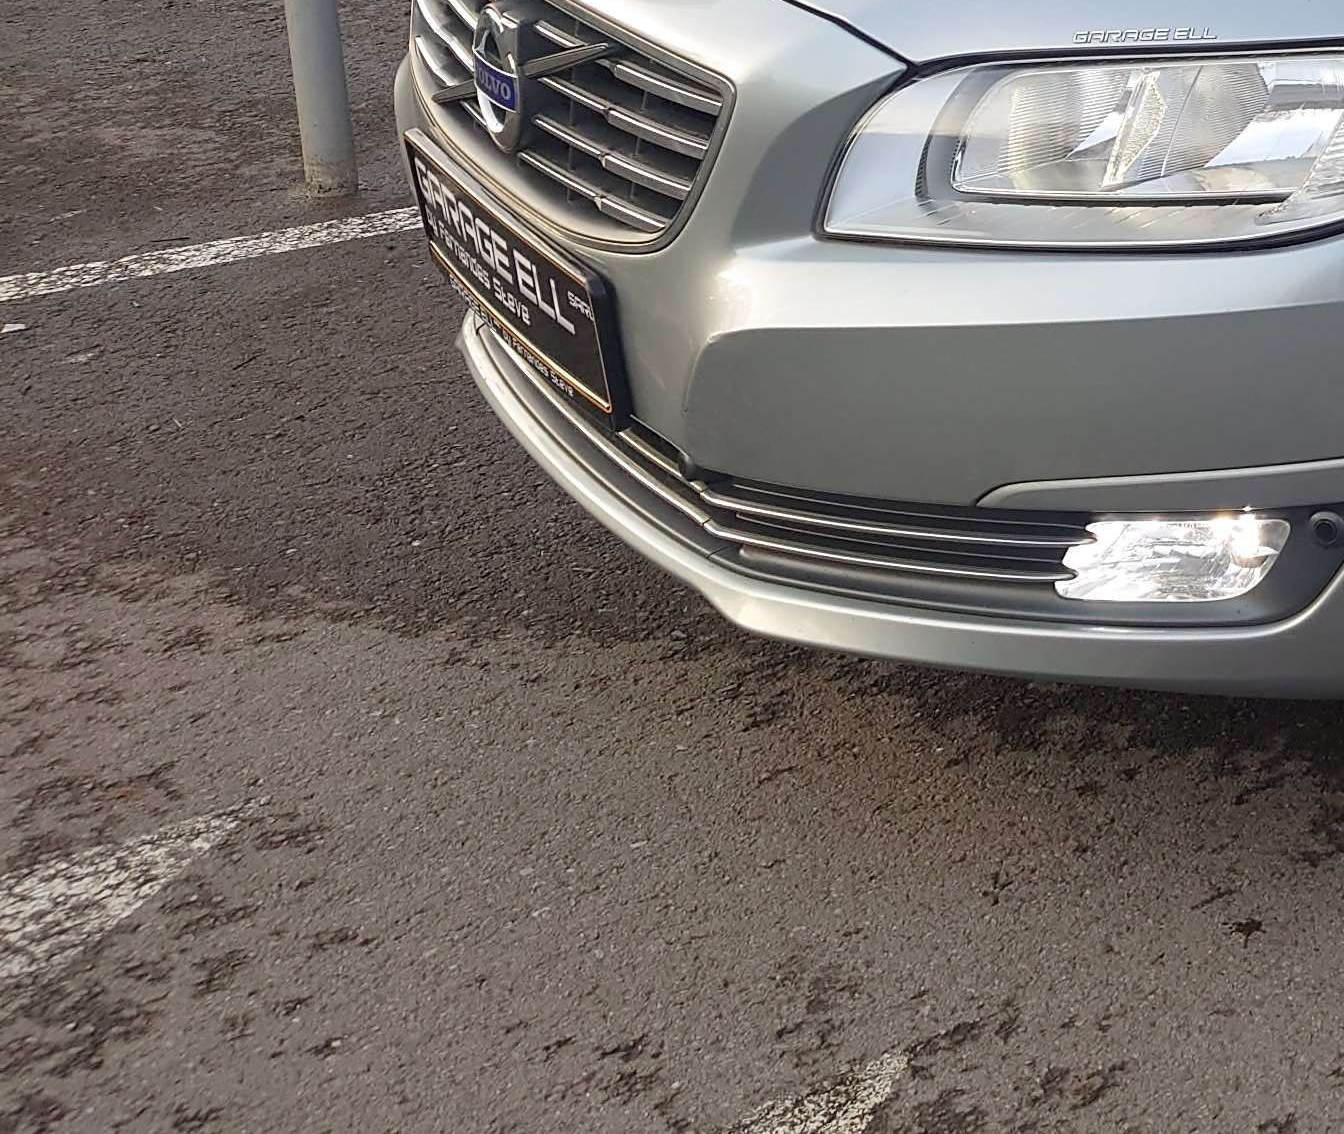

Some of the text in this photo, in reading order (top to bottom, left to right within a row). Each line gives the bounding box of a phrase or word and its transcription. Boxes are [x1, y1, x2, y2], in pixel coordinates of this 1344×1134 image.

[1072, 26, 1218, 44] GARAGE ELL
[414, 156, 514, 285] GARAGE
[513, 248, 576, 335] ELL
[438, 220, 491, 290] Fernandes
[493, 277, 532, 327] Steve
